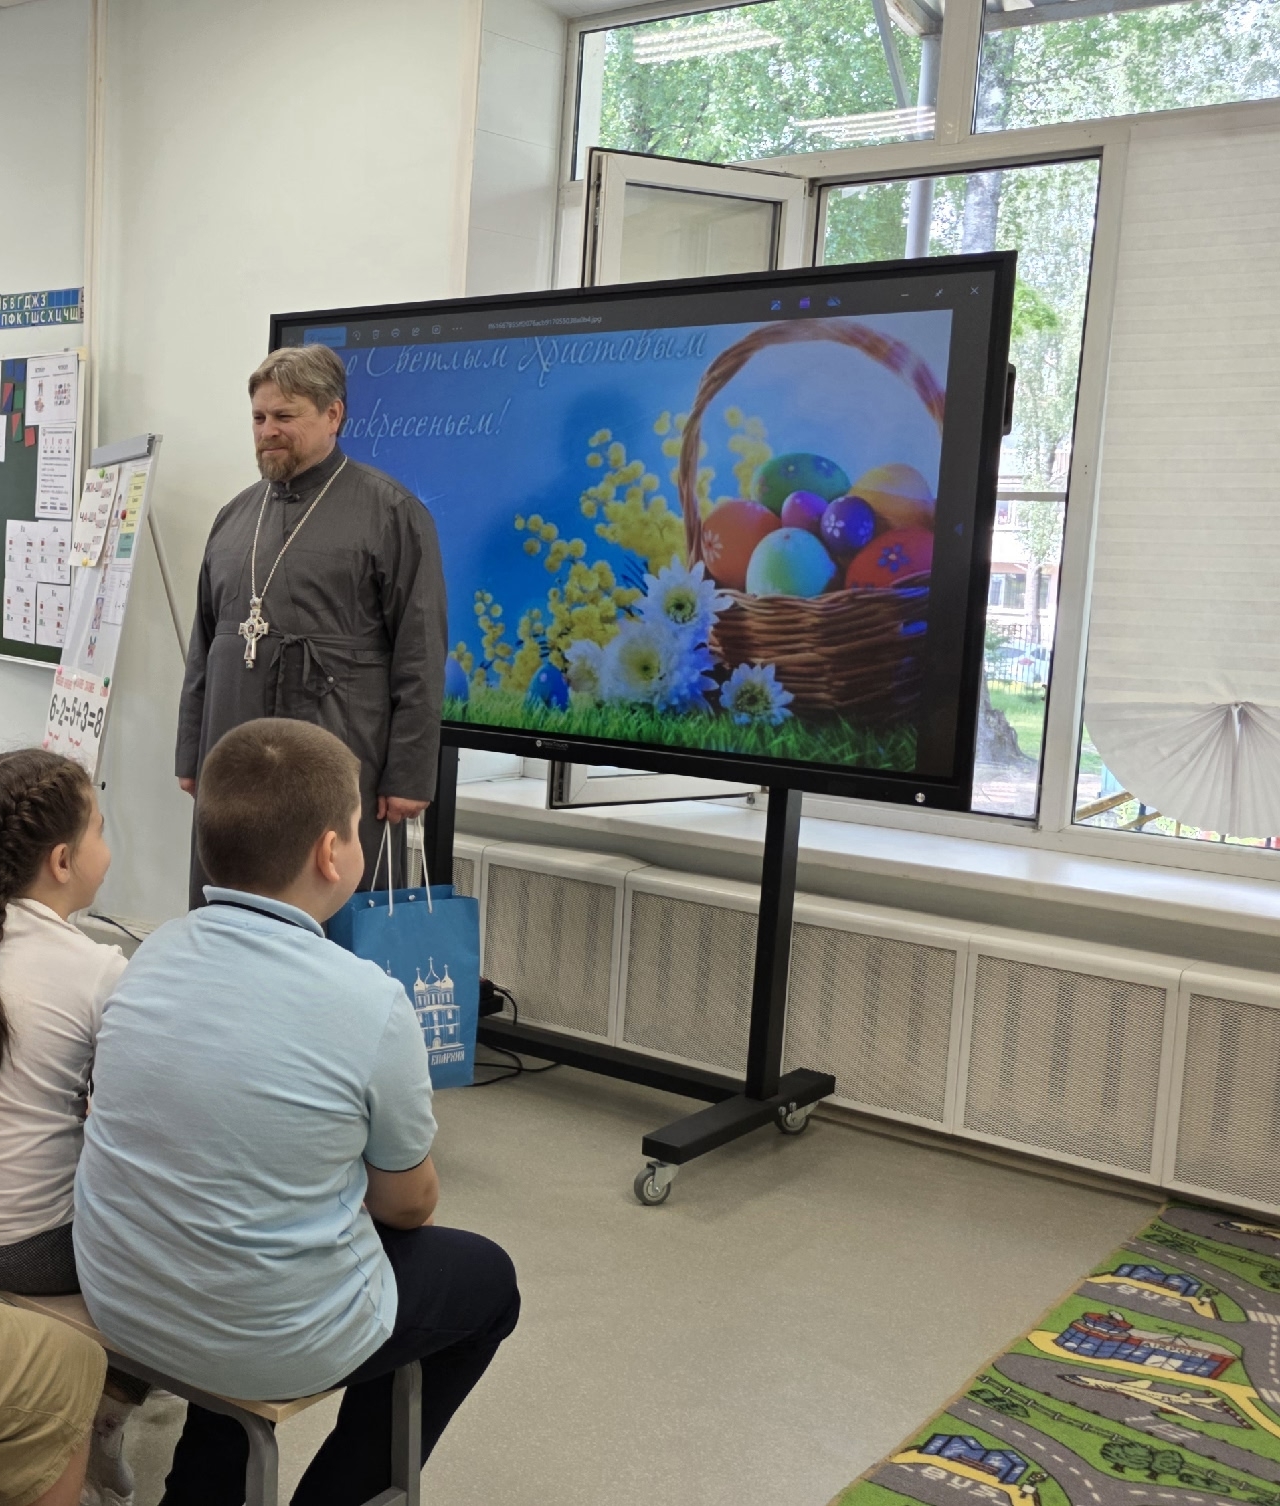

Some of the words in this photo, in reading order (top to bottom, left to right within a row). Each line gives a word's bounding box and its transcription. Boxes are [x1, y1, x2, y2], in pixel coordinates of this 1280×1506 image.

[346, 354, 358, 377] о
[366, 345, 508, 378] Светлым
[517, 329, 706, 388] Христовым
[340, 398, 512, 457] оскресеньем!
